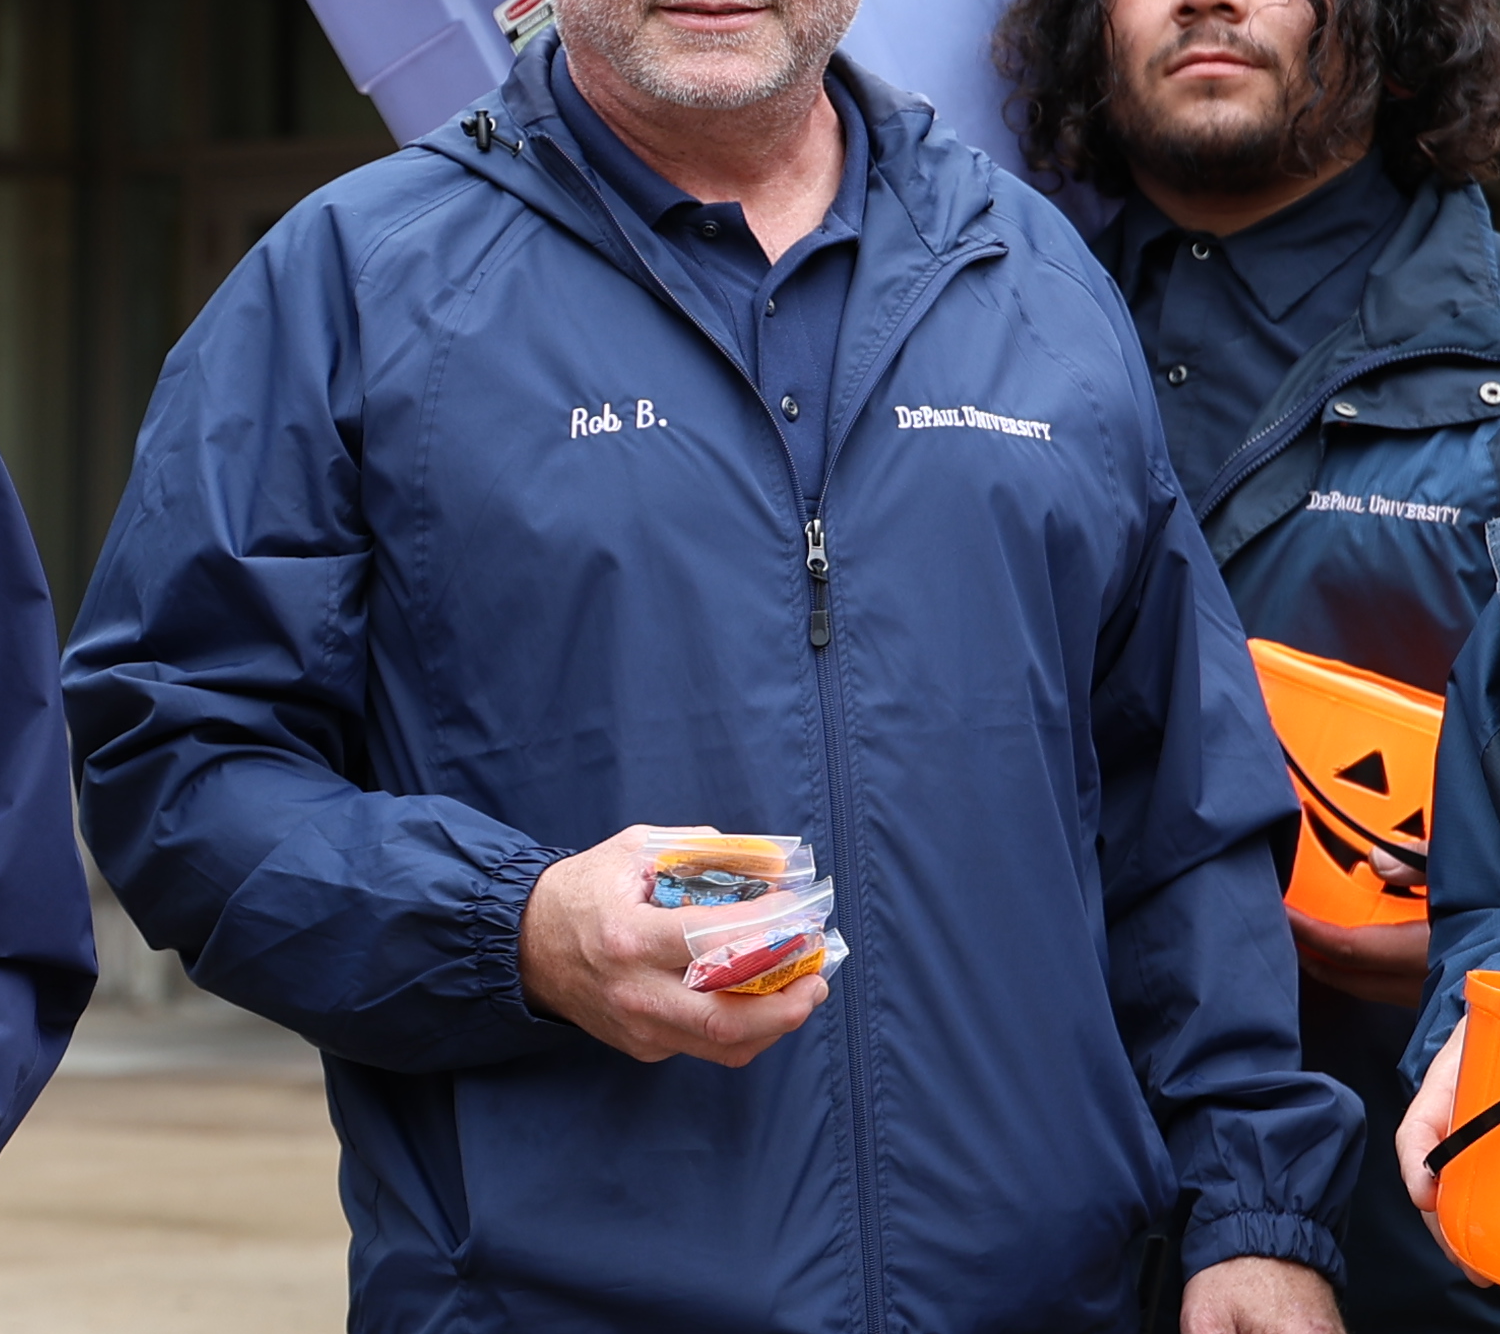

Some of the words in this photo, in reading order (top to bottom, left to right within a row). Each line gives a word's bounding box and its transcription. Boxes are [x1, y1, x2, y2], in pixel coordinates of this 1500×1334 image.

[570, 402, 623, 439] Rob
[635, 398, 669, 429] B.
[960, 405, 1052, 442] UNIVERSITY
[1368, 493, 1461, 526] UNIVERSITY
